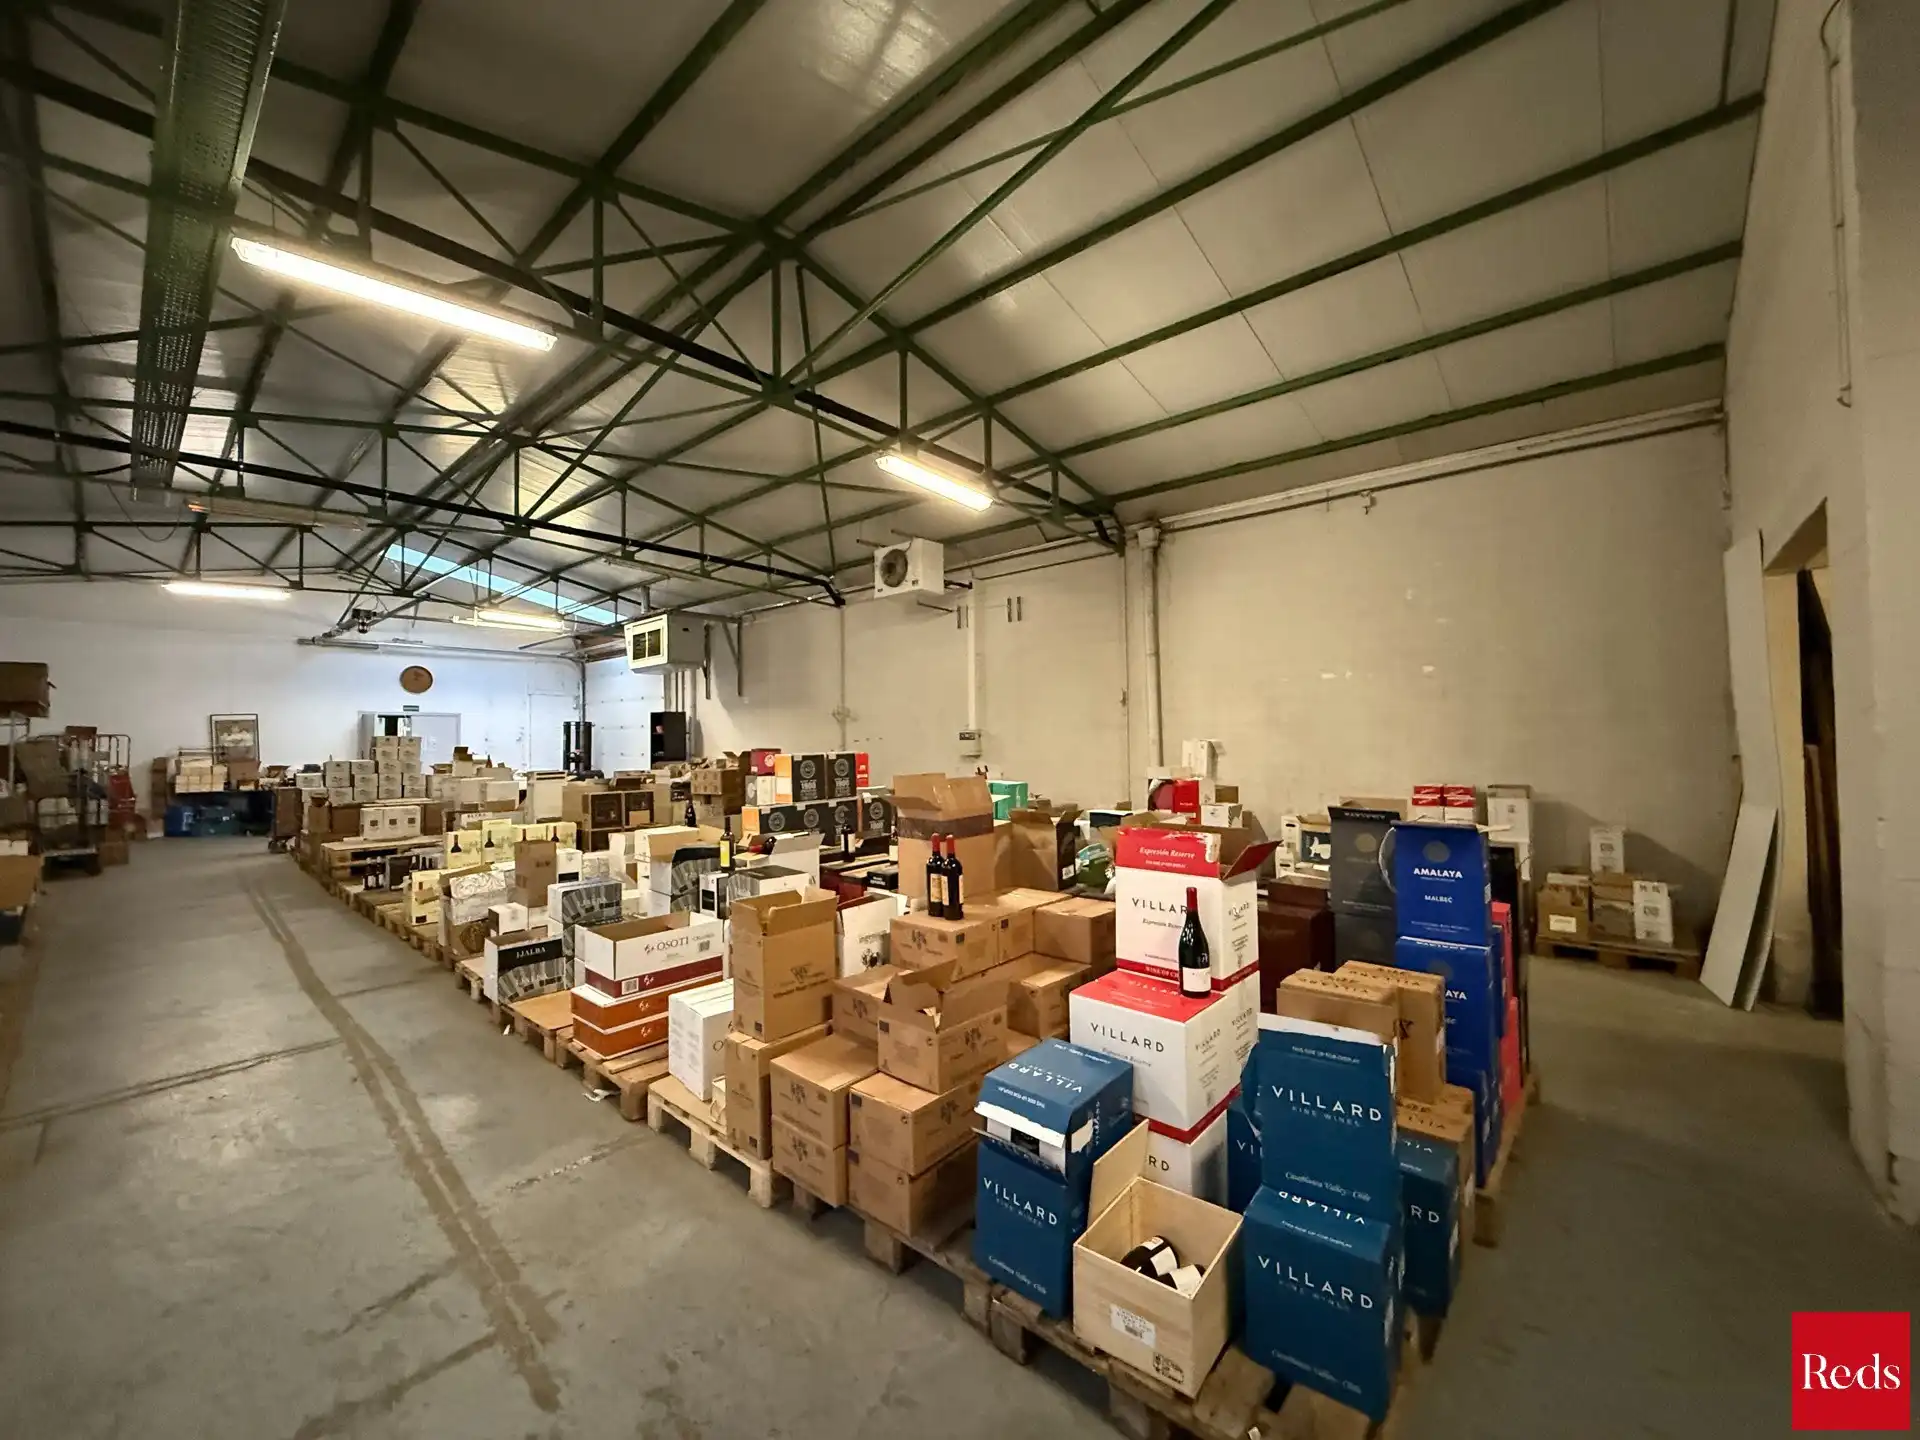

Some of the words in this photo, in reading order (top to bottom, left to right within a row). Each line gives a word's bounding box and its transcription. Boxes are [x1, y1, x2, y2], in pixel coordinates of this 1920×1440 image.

[1413, 867, 1463, 879] AMALAYA
[1132, 897, 1187, 914] VILLAR
[1424, 894, 1453, 904] MALBEC
[656, 935, 689, 951] OSOTI
[1090, 1022, 1165, 1053] VILLARD
[1008, 1062, 1083, 1093] VILLARD
[1272, 1085, 1382, 1121] VILLARD
[983, 1177, 1058, 1226] VILLARD
[1278, 1190, 1365, 1225] VILLARD
[1257, 1255, 1373, 1309] VILLARD
